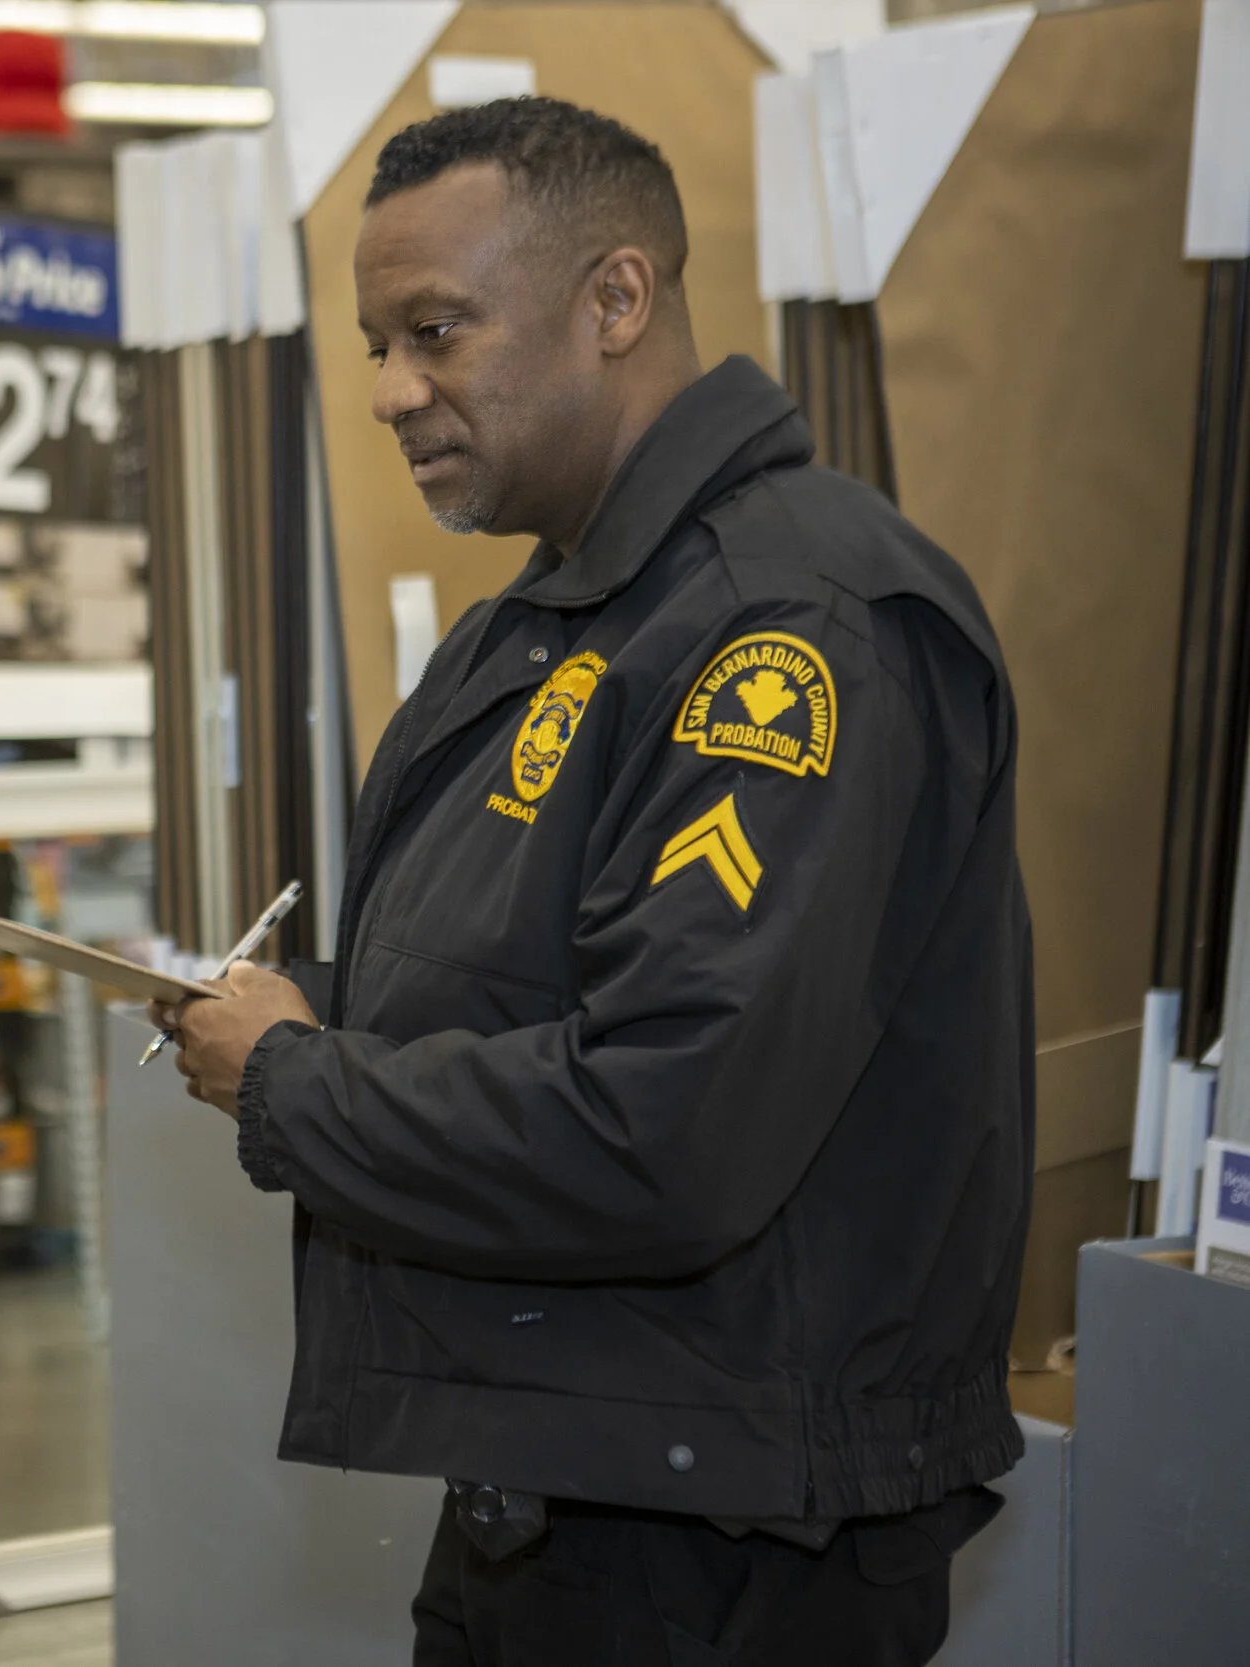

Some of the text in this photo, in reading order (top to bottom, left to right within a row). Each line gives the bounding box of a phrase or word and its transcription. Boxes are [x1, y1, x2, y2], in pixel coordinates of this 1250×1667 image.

[6, 245, 107, 318] Price
[687, 644, 829, 759] SAN BERNARDINO COUNTY
[709, 722, 802, 762] PROBATION
[485, 793, 538, 825] PROBAT
